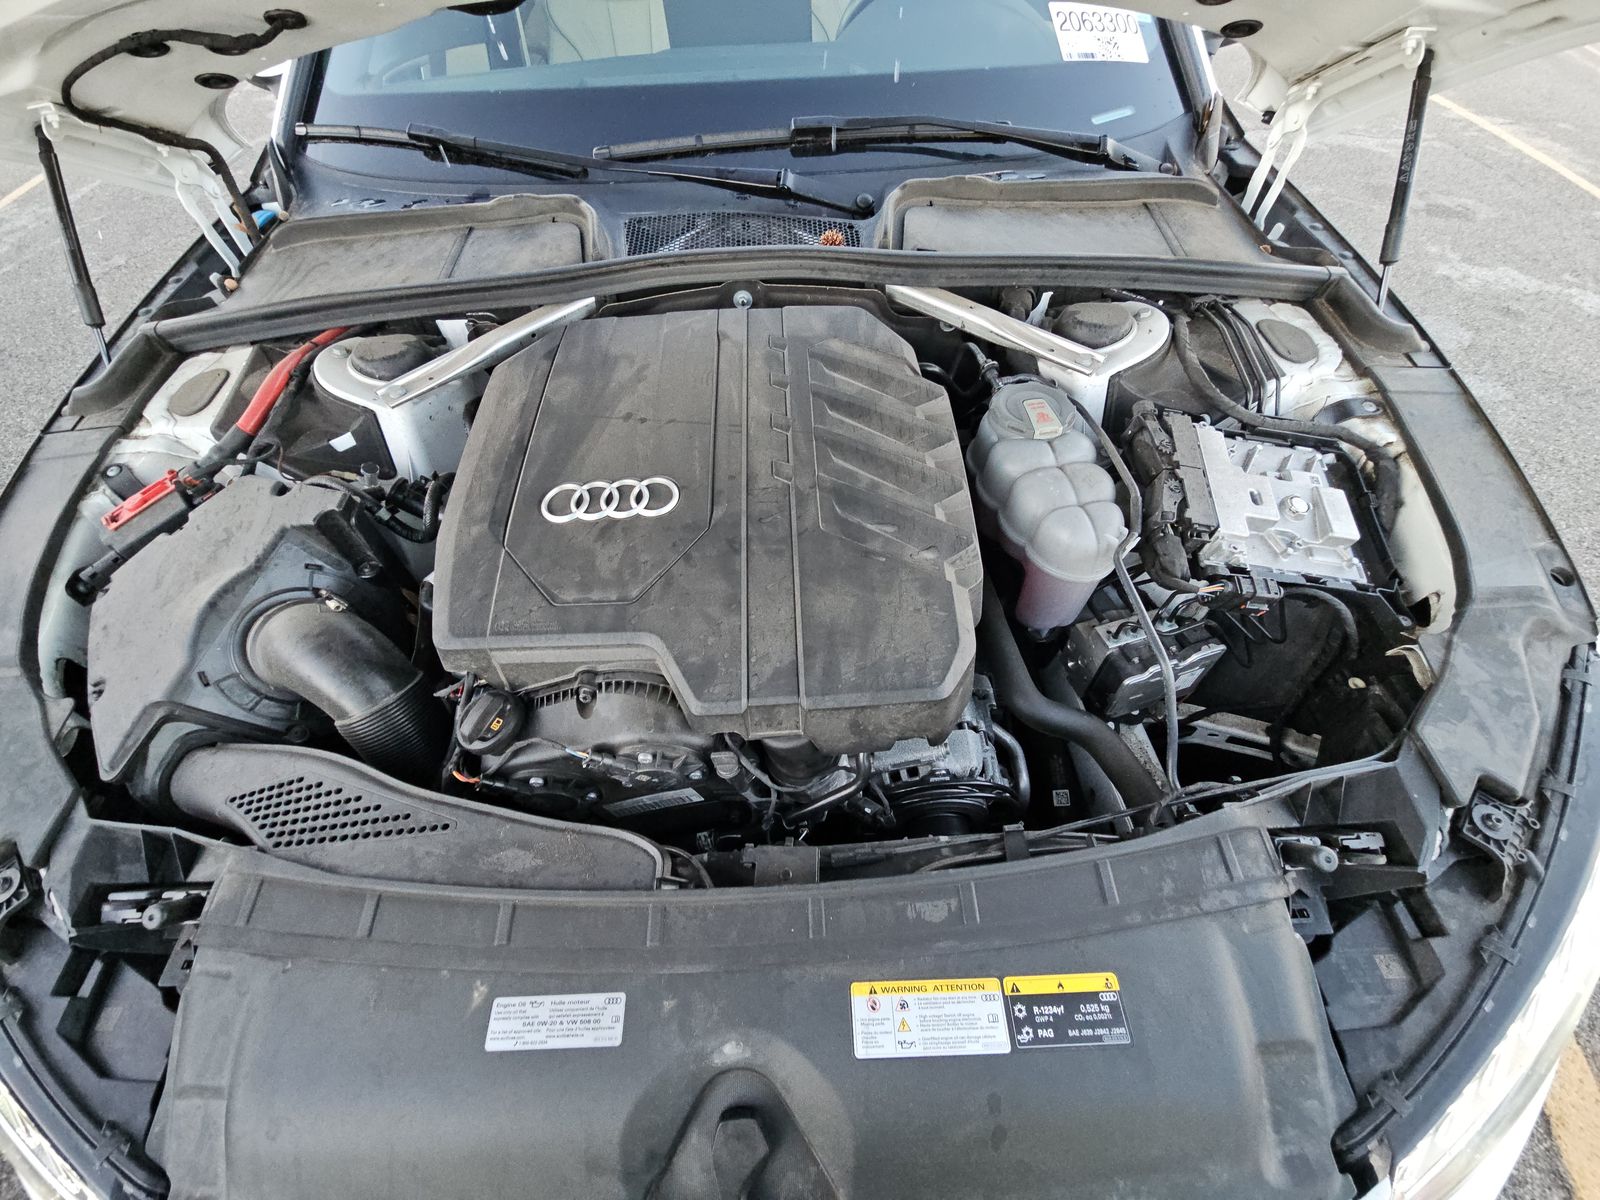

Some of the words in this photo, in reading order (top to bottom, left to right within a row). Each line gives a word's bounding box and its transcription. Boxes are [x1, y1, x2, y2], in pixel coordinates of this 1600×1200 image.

[1056, 11, 1138, 34] 2063300
[880, 985, 928, 994] WARNING
[932, 983, 985, 992] ATTENTION
[1033, 1004, 1065, 1016] R-1234yf
[1100, 1003, 1110, 1013] kg
[1037, 1028, 1055, 1038] PAG
